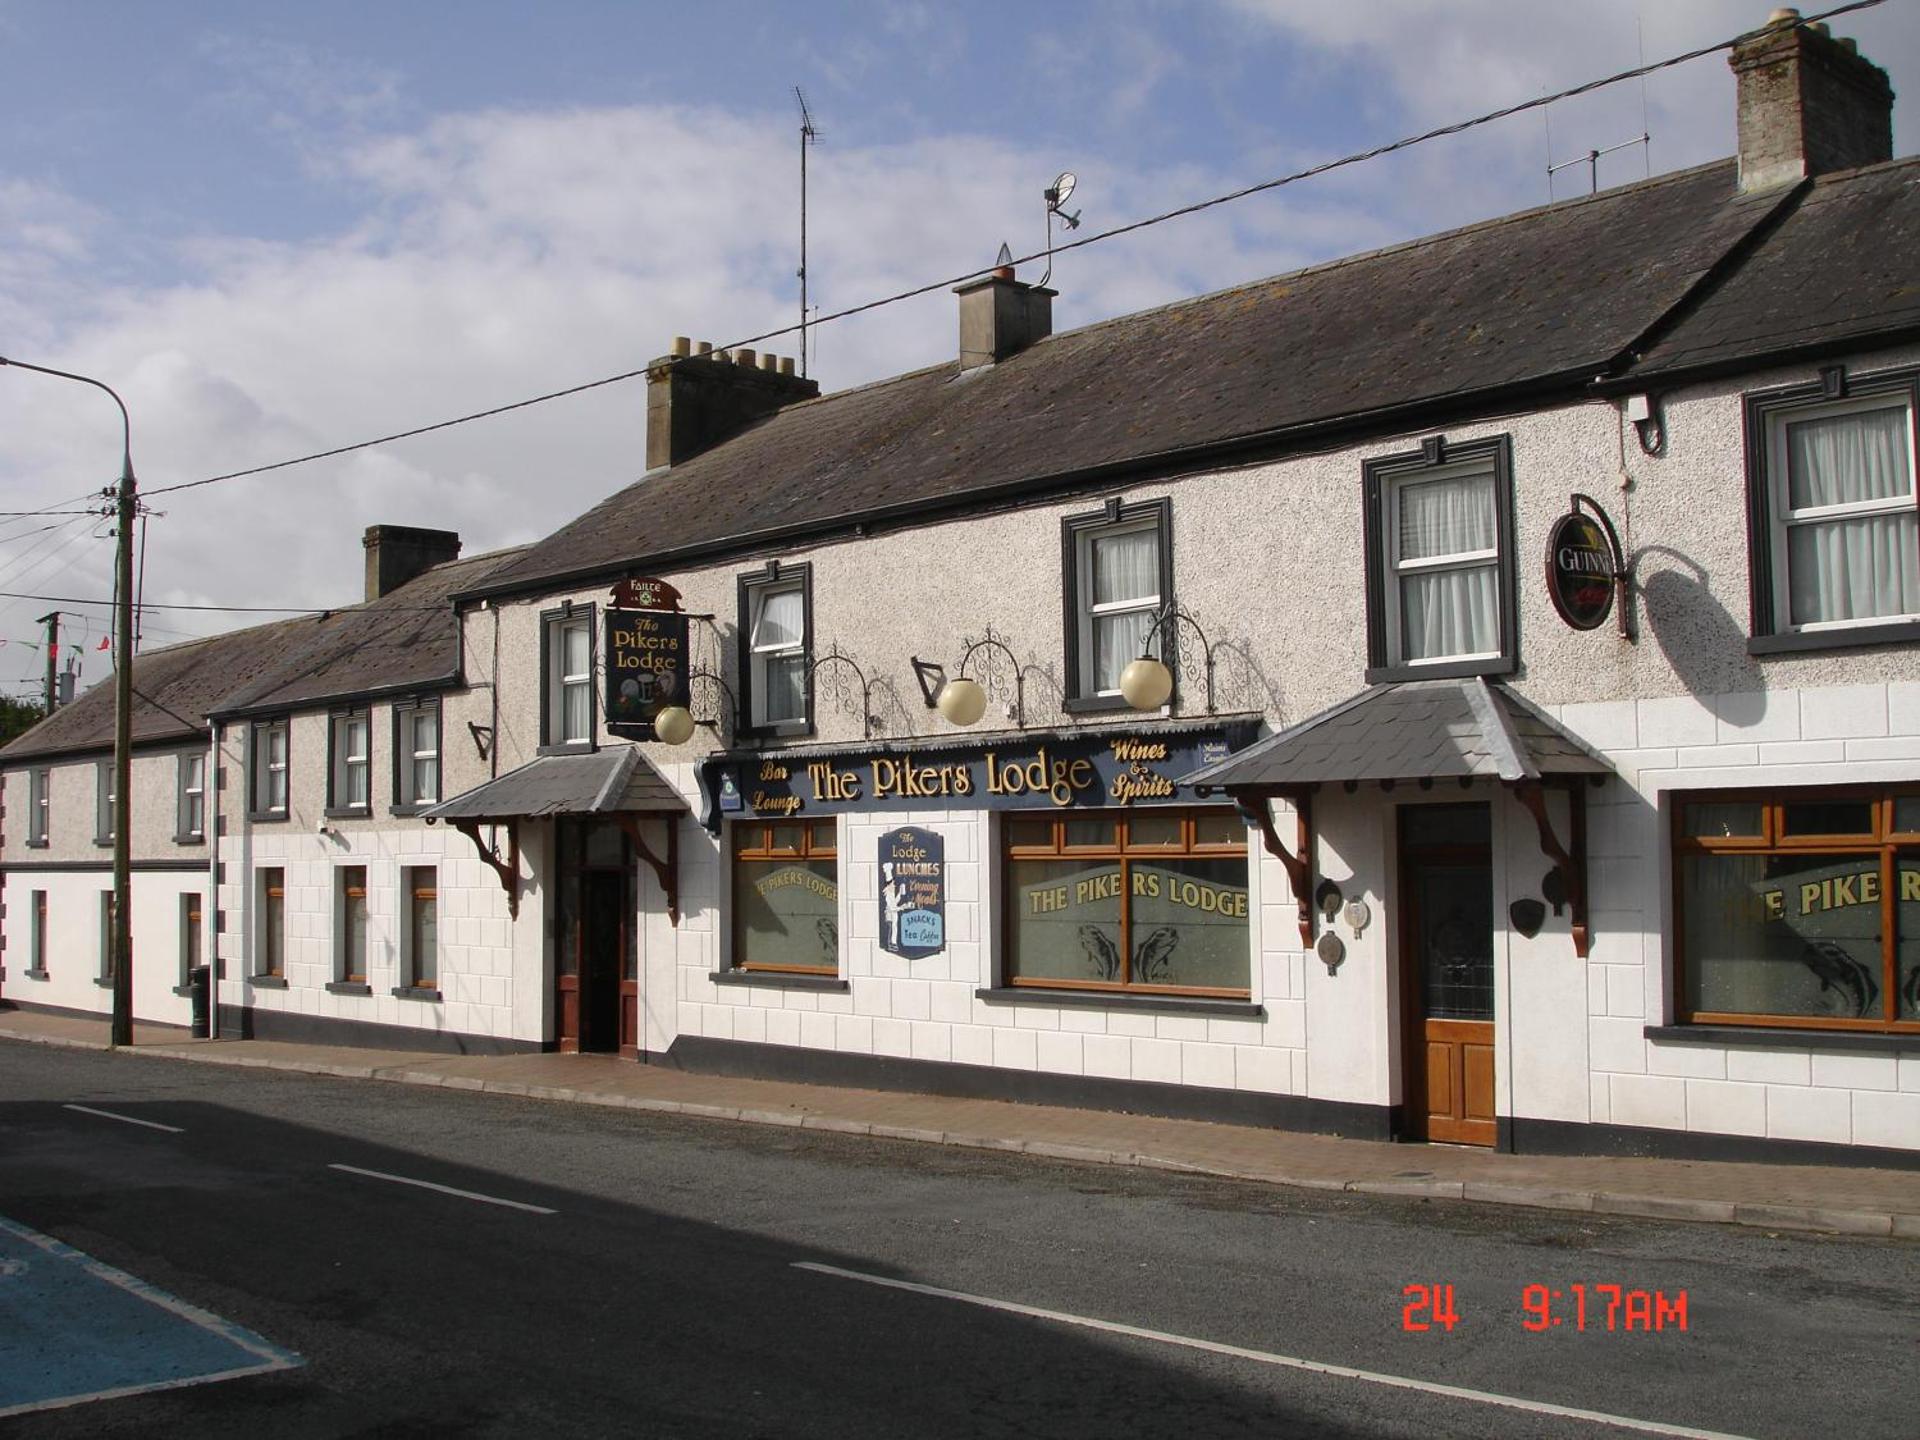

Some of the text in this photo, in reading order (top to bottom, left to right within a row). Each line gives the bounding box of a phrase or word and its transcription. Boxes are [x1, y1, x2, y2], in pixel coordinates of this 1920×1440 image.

[635, 618, 659, 632] The
[614, 630, 678, 650] Pikers
[616, 651, 677, 675] Lodge
[1110, 738, 1167, 762] Wines
[760, 760, 788, 781] Bar
[808, 745, 1092, 806] The Pikers Lodge
[1109, 773, 1174, 806] Spirits
[751, 790, 801, 816] Lounge
[892, 844, 927, 862] Lodge
[769, 871, 803, 890] PIKERS
[896, 862, 940, 877] LUNCHES
[1029, 871, 1248, 918] THE PIKERS LODGE
